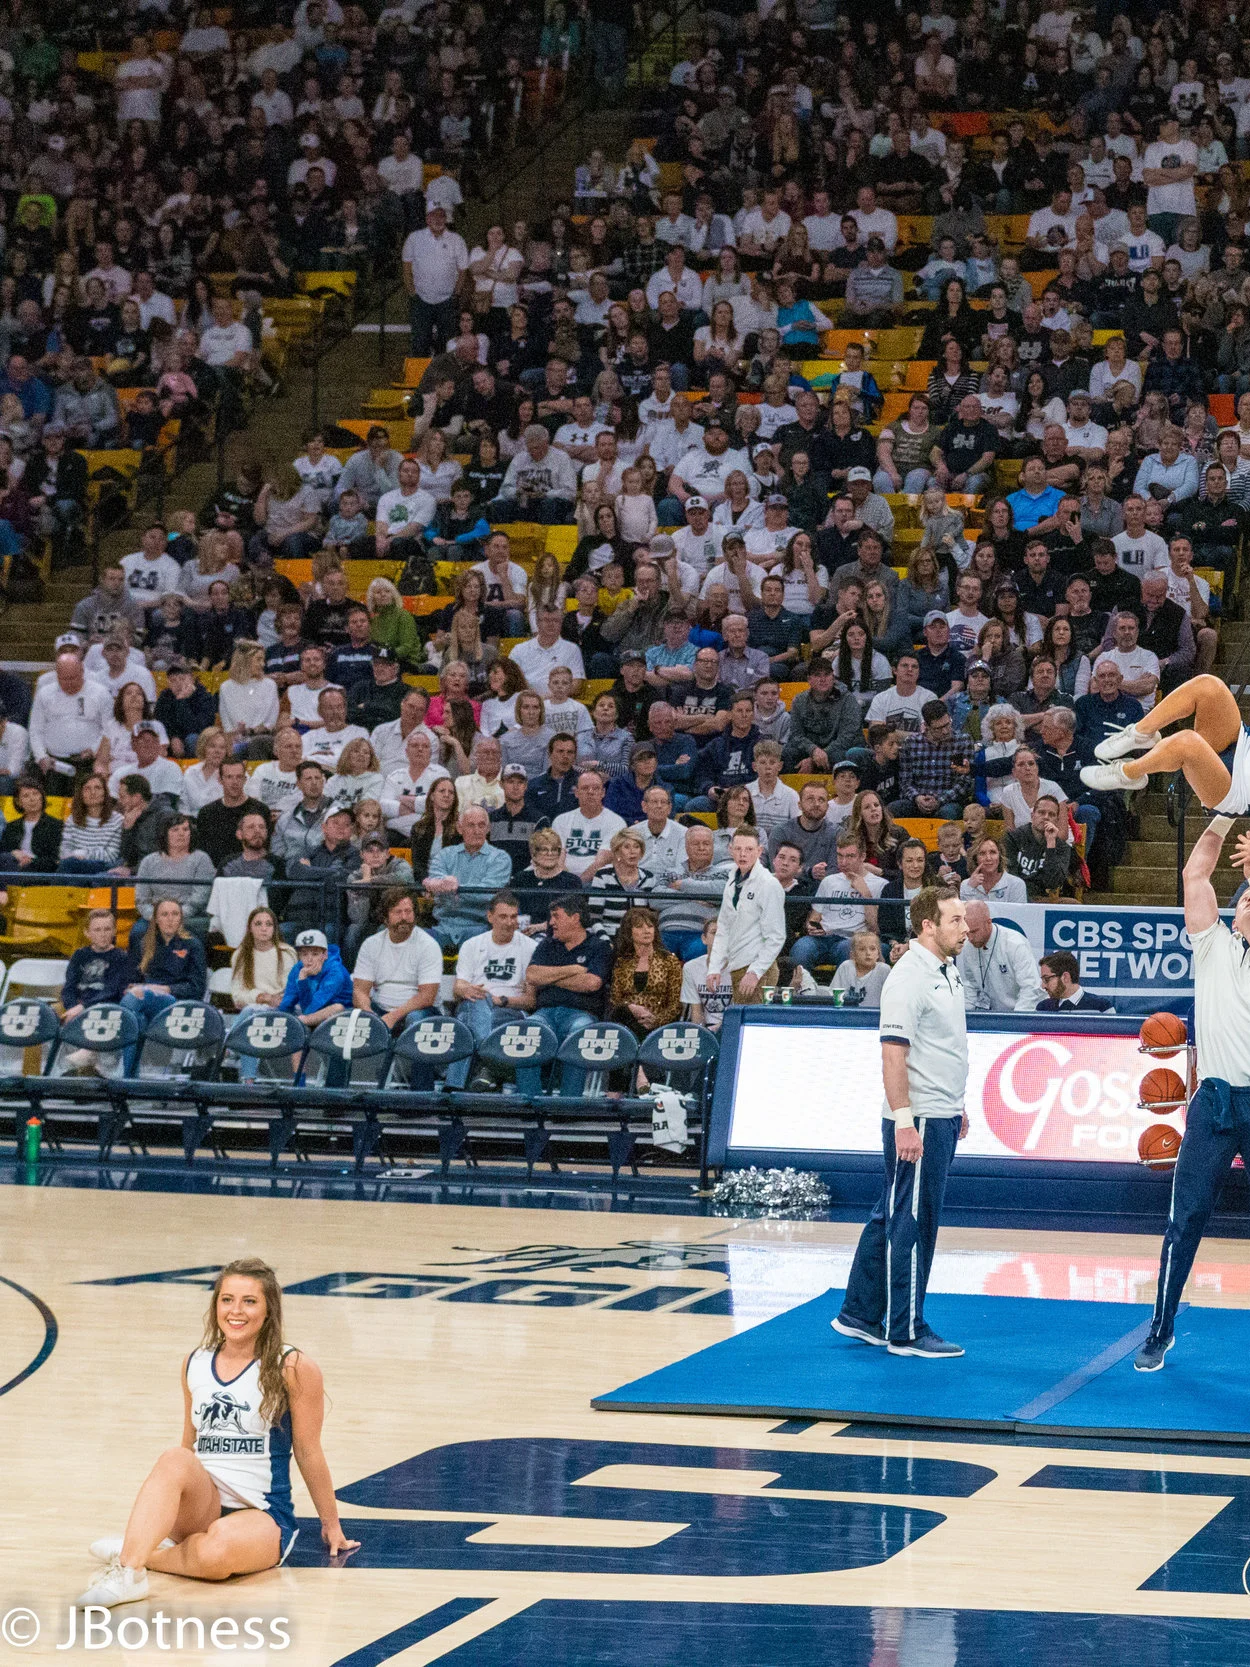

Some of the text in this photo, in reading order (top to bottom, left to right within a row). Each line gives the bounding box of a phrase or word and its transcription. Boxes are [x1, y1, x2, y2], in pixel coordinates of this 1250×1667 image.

[566, 837, 602, 851] STATE
[1052, 919, 1123, 949] CBS
[483, 964, 518, 975] STATE
[1054, 950, 1195, 980] ETWO
[715, 985, 733, 993] STATE
[222, 1437, 263, 1453] STATE
